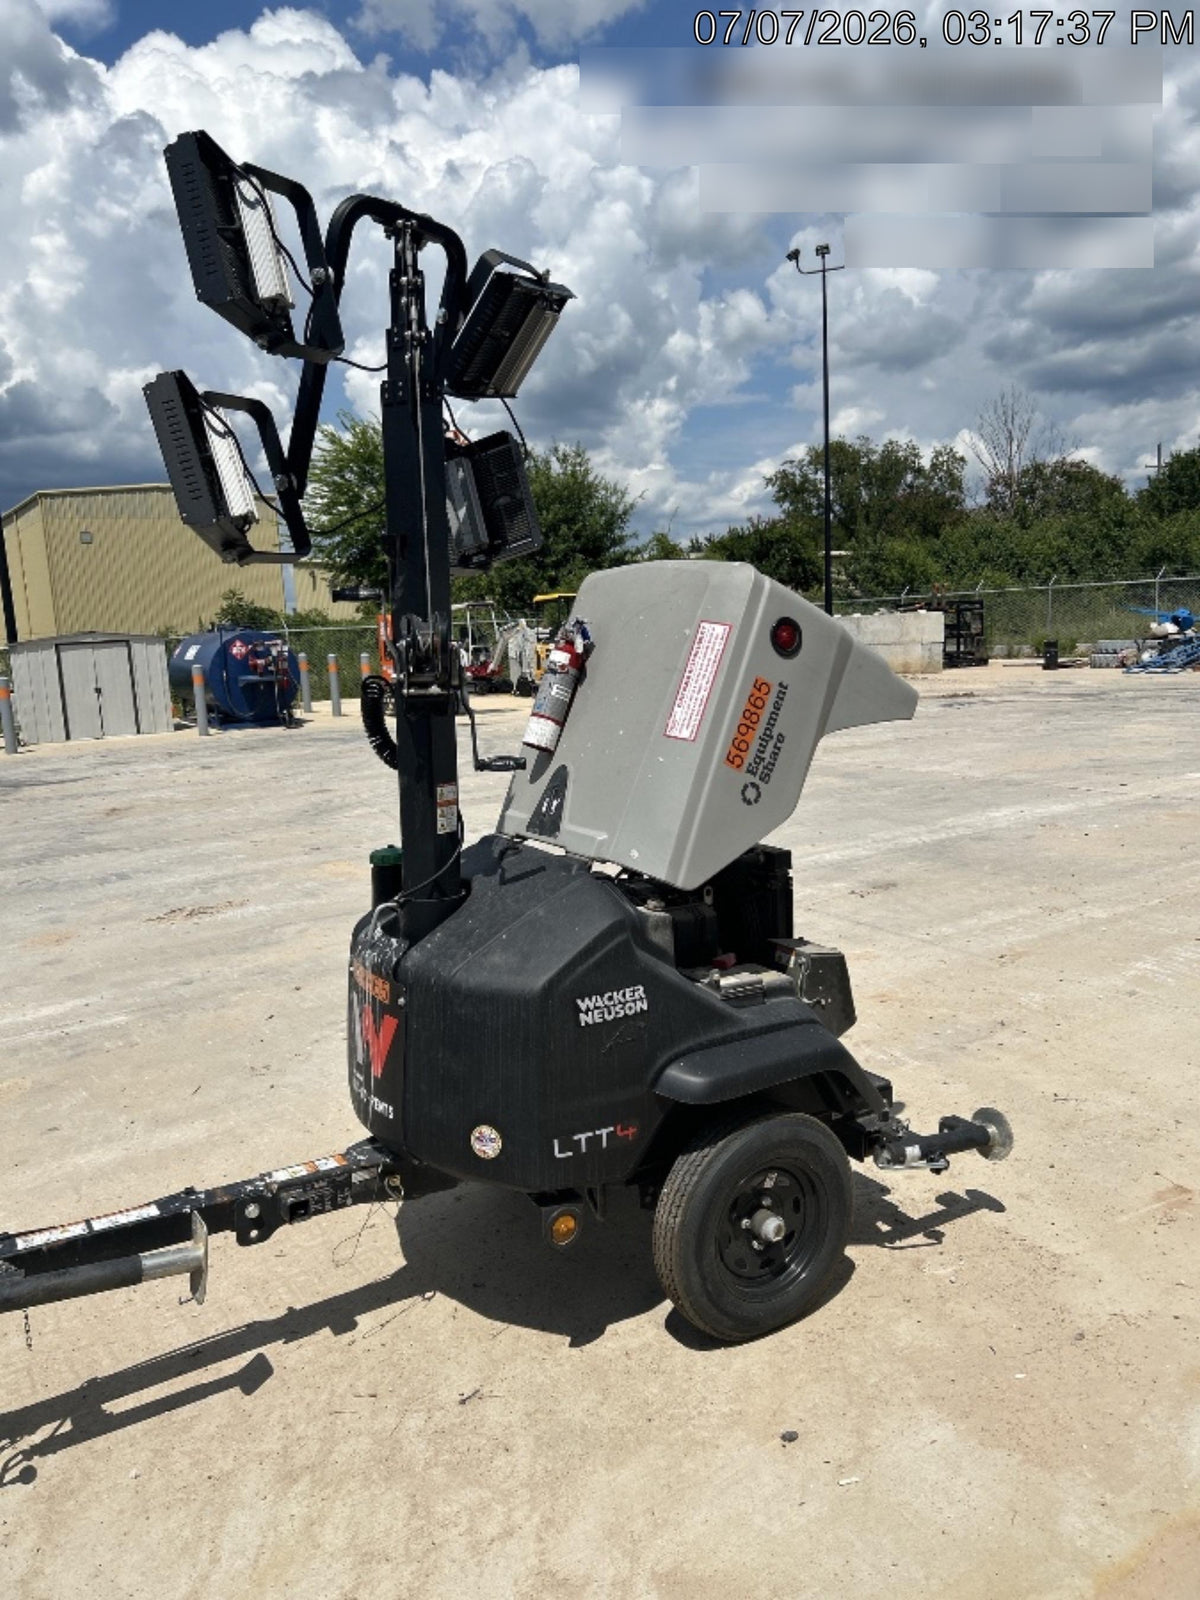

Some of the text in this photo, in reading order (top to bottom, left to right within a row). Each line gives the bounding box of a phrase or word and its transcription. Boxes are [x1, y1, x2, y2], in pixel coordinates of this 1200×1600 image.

[726, 678, 771, 769] 569865
[745, 681, 789, 777] Equipment
[576, 984, 646, 1012] WACKER
[579, 998, 648, 1026] NEUSON
[553, 1124, 638, 1159] LTT4
